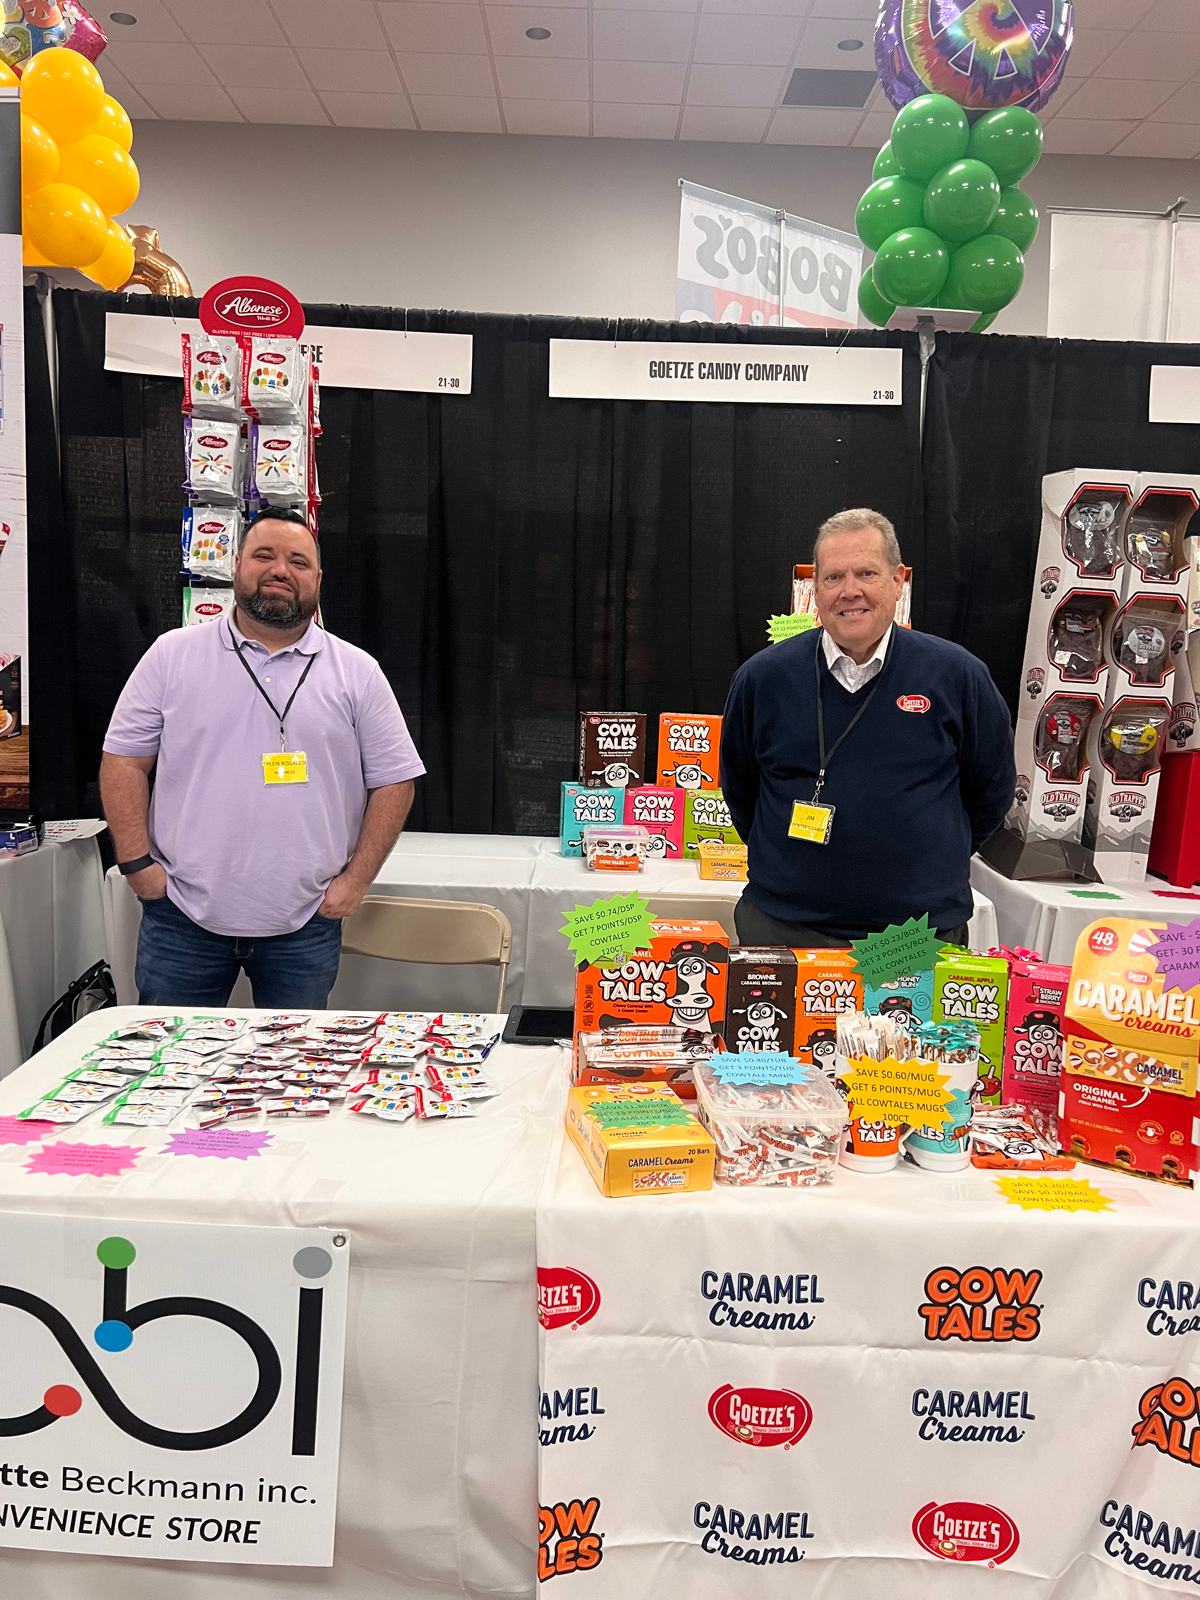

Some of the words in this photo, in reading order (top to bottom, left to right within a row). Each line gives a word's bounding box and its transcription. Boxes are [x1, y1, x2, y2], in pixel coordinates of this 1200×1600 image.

[221, 296, 283, 317] Albanese
[258, 353, 284, 363] Albanese
[649, 360, 694, 379] GOETZE
[698, 361, 741, 381] CANDY
[744, 363, 809, 382] COMPANY
[438, 377, 460, 389] 21-30
[873, 390, 895, 401] 21-30
[199, 436, 226, 448] Albanese
[264, 440, 291, 450] Albanese
[598, 724, 637, 737] COW
[668, 724, 710, 739] COW
[596, 736, 638, 750] TALES
[668, 738, 711, 753] TALES
[574, 795, 615, 809] COW
[633, 795, 675, 809] COW
[693, 797, 730, 814] COW
[1040, 793, 1056, 804] OLD
[1055, 792, 1080, 805] TRAPPER
[1108, 795, 1120, 805] OLD
[1120, 793, 1148, 808] TRAPPER
[574, 808, 616, 822] TALES
[632, 808, 676, 822] TALES
[692, 811, 734, 827] TALES
[574, 914, 594, 925] SAVE
[595, 903, 635, 920] $0.74/DSP
[573, 929, 588, 938] GET
[597, 914, 642, 932] POINTS/DSP
[590, 931, 630, 947] COWTALES
[859, 942, 881, 956] SAVE
[880, 926, 921, 948] $0.23/BOX
[1092, 931, 1114, 946] 48
[1159, 932, 1186, 943] SAVE
[602, 945, 624, 956] 120CT
[860, 957, 875, 968] GET
[876, 954, 881, 962] 2
[882, 936, 930, 959] POINTS/BOX
[1156, 948, 1179, 958] GET-
[1182, 946, 1194, 956] 30
[871, 966, 884, 976] ALL
[886, 949, 927, 970] COWTALES
[602, 961, 666, 981] COW
[894, 966, 912, 977] 36CT
[948, 975, 976, 983] CARAMEL
[598, 980, 667, 1002] TALES
[804, 980, 856, 997] COW
[942, 982, 1000, 1003] COW
[1039, 988, 1064, 996] STRAW
[802, 996, 857, 1013] TALES
[1040, 994, 1062, 1002] BERRY
[1072, 978, 1200, 1026] CARAMEL
[940, 998, 1000, 1020] TALES
[738, 1026, 779, 1041] COW
[1124, 1016, 1196, 1038] creams
[736, 1040, 781, 1054] TALES
[1014, 1039, 1063, 1060] COW
[856, 1068, 878, 1078] SAVE
[881, 1070, 935, 1082] $0.60/MUG
[1136, 1062, 1184, 1080] CARAMEL
[1156, 1076, 1183, 1085] creams
[851, 1082, 869, 1091] GET
[871, 1084, 877, 1092] 6
[880, 1085, 941, 1098] POINTS/MUG
[1073, 1082, 1127, 1102] ORIGINAL
[850, 1097, 865, 1106] ALL
[866, 1098, 915, 1110] COWTALES
[916, 1102, 945, 1113] MUGS
[1081, 1094, 1117, 1106] CARAMEL
[628, 1108, 681, 1116] POINTS/BOX
[883, 1114, 910, 1123] 100CT
[858, 1129, 897, 1143] TALES
[628, 1157, 663, 1168] CARAMEL
[664, 1158, 696, 1166] Creams
[700, 1270, 825, 1305] CARAMEL
[924, 1266, 1043, 1306] COW
[709, 1300, 812, 1331] Creams
[918, 1302, 1041, 1342] TALES
[911, 1388, 1036, 1421] CARAMEL
[1138, 1376, 1200, 1421] CO
[729, 1394, 795, 1428] GOETZE'S
[918, 1415, 1022, 1444] Creams
[62, 1466, 244, 1502] Beckmann
[258, 1477, 317, 1505] inc.
[693, 1501, 815, 1542] CARAMEL
[933, 1510, 1001, 1542] GOETZE'S
[1099, 1499, 1200, 1556] CARAM
[165, 1516, 261, 1545] STORE
[700, 1529, 802, 1566] Creams
